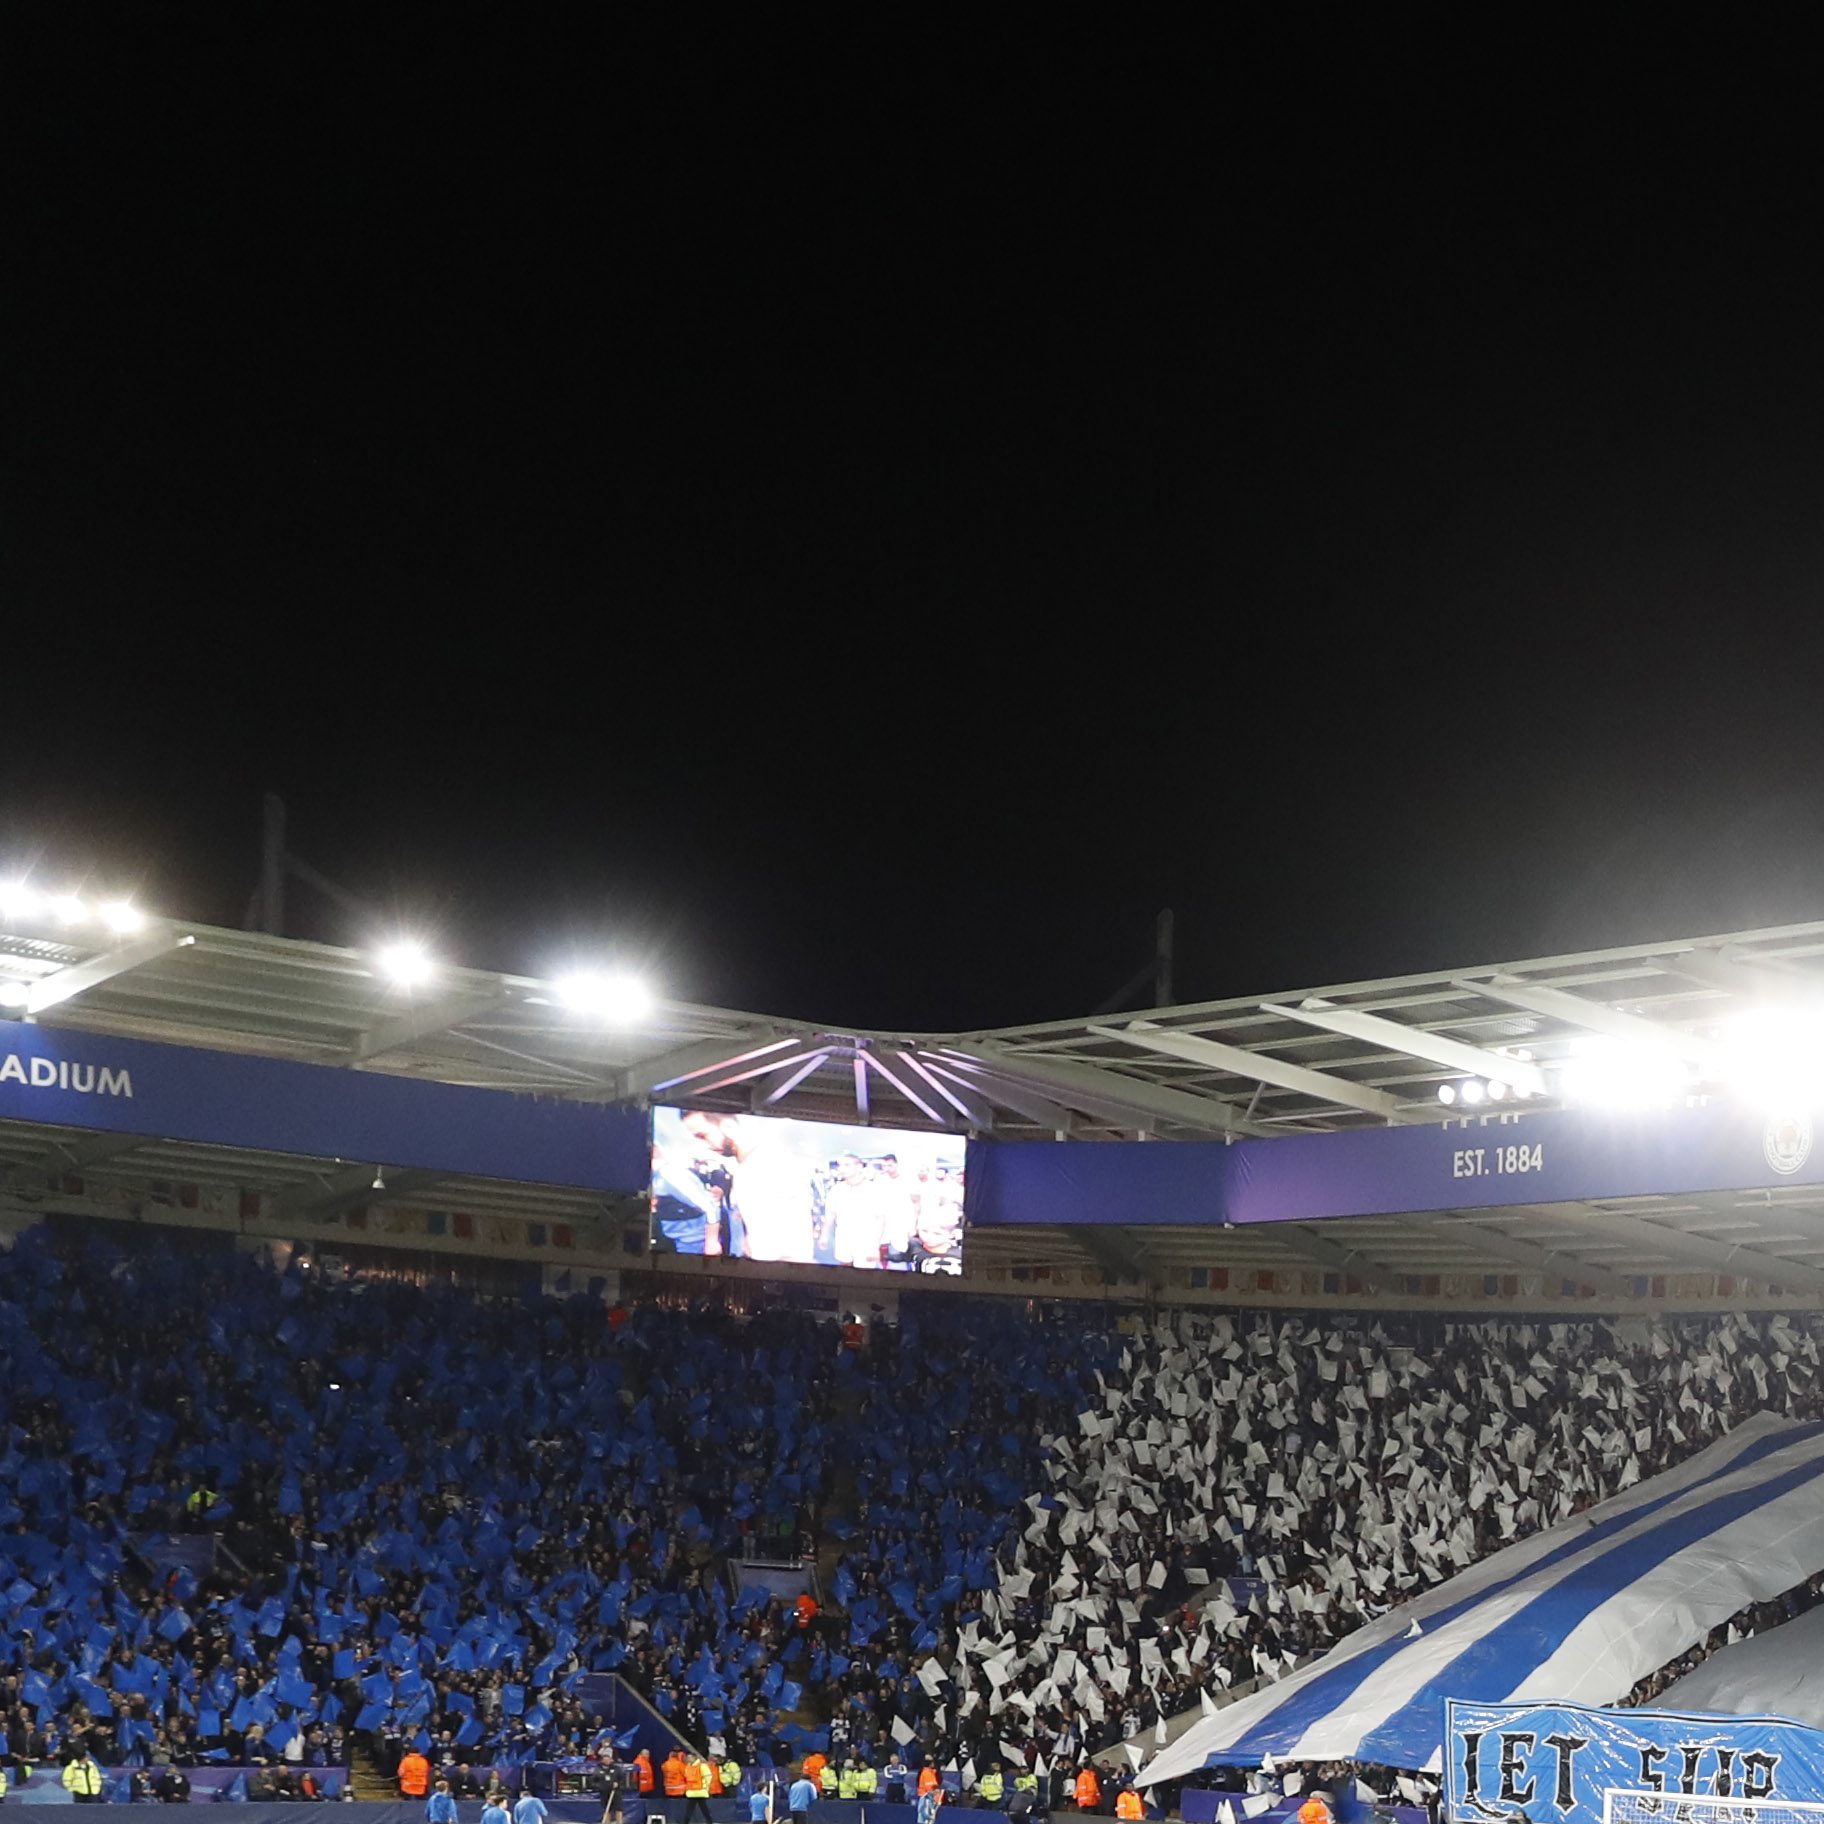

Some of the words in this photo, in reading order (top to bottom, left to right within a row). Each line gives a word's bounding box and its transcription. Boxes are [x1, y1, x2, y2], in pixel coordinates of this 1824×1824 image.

[0, 1054, 133, 1098] ADIUM
[1453, 1148, 1490, 1178] EST.
[1496, 1143, 1543, 1174] 1884
[1461, 1730, 1589, 1819] LET
